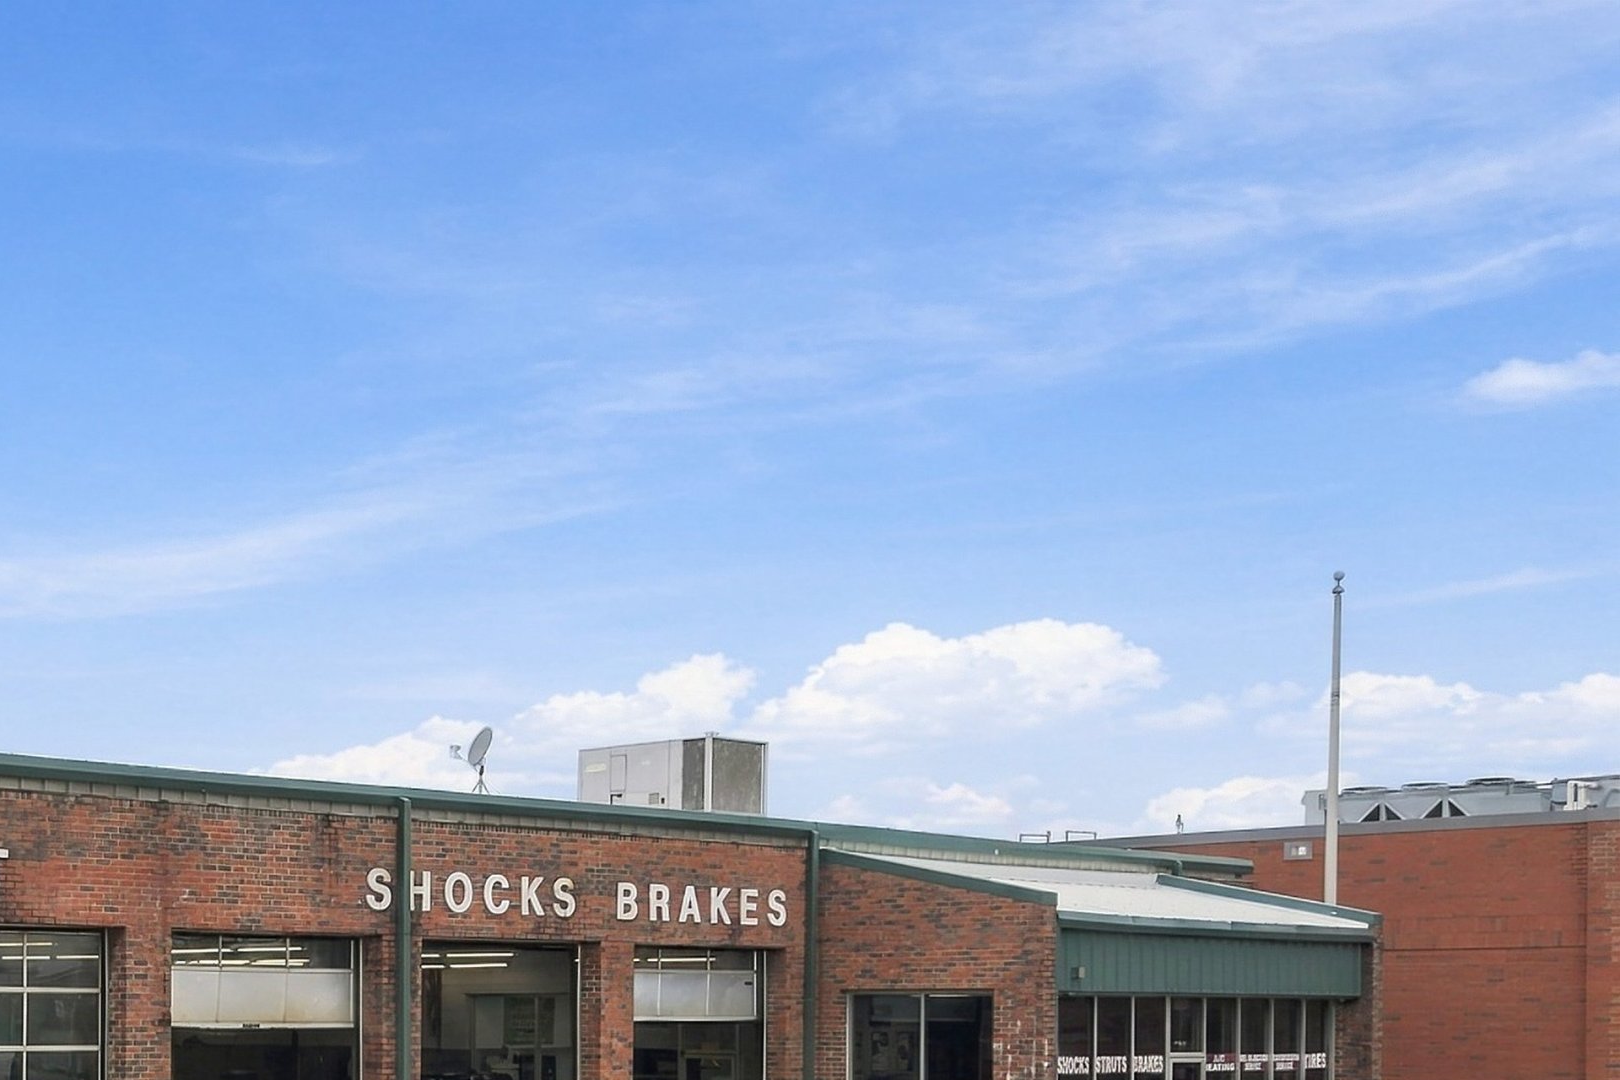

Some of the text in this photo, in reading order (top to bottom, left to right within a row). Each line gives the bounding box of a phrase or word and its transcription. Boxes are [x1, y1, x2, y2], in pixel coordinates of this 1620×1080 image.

[365, 867, 788, 927] SHOCKS BRAKES
[1057, 1056, 1089, 1074] SHOCKS
[1095, 1056, 1127, 1073] STRUTS
[1134, 1055, 1163, 1072] BRAKES
[1304, 1053, 1327, 1069] TIRES
